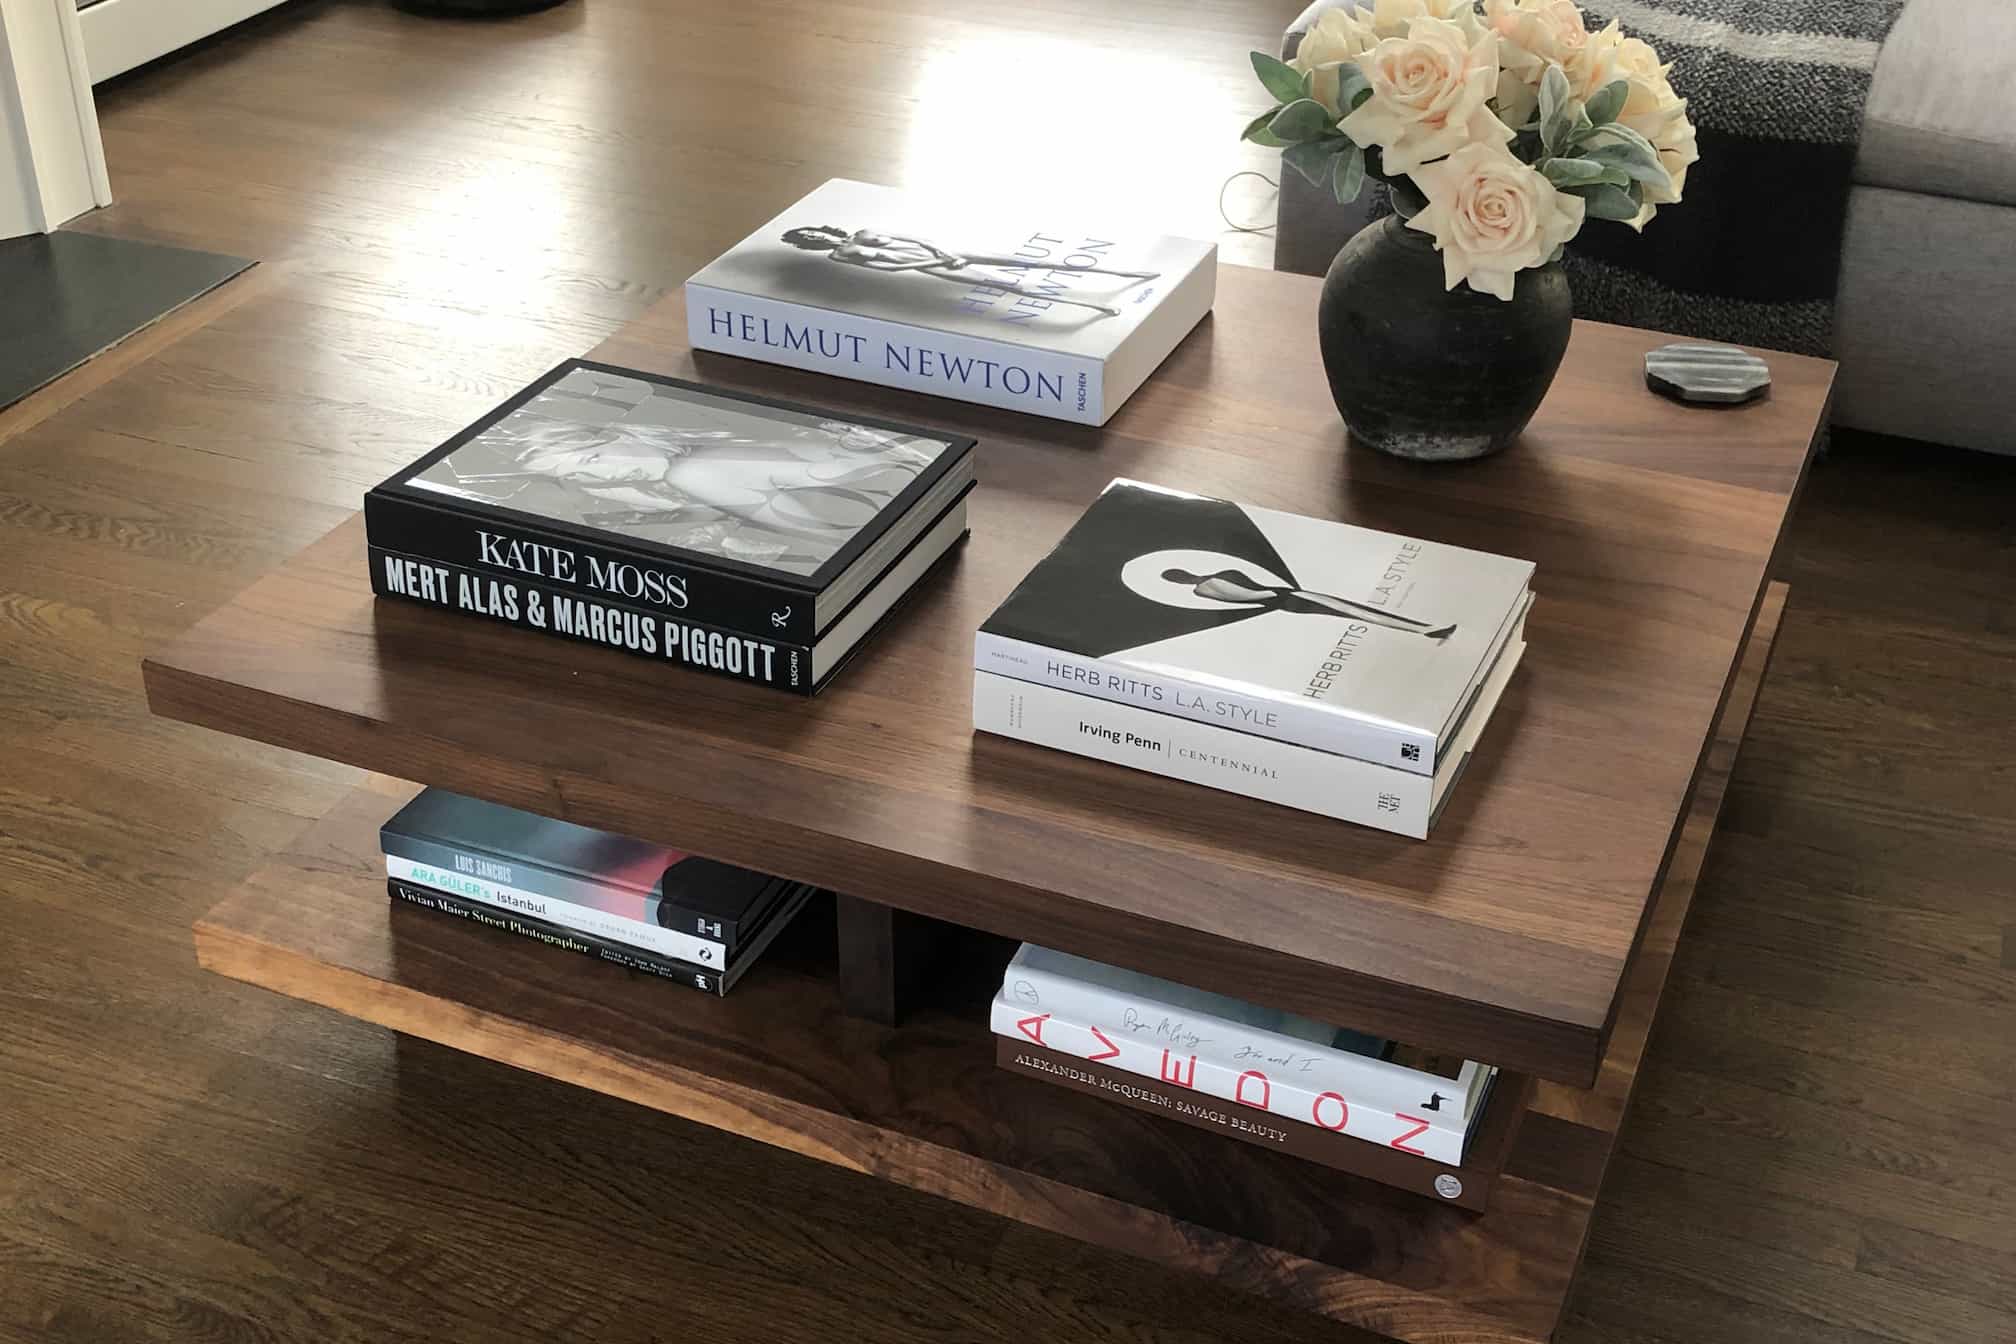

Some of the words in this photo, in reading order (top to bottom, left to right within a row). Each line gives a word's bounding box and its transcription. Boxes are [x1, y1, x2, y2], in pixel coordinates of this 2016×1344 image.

[957, 232, 1064, 315] HELMUT
[998, 237, 1116, 328] NEWTON
[709, 307, 868, 362] HELMUT
[885, 343, 1065, 402] NEWTON
[1077, 372, 1087, 413] TASCHEN
[475, 530, 578, 583] KATE
[585, 555, 689, 609] MOSS
[1383, 543, 1422, 582] STYLE
[384, 555, 450, 604] MERT
[458, 573, 519, 627] ALAS
[526, 590, 547, 628] &
[553, 595, 657, 654] MARCUS
[664, 621, 776, 682] PIGGOTT
[789, 650, 799, 687] TASCHEN
[1047, 660, 1101, 685] HERB
[1108, 675, 1163, 701] RITTS
[1175, 690, 1209, 713] L.A.
[1215, 701, 1279, 728] STYLE
[1303, 658, 1342, 699] HERB
[1336, 623, 1368, 661] RITTS
[1079, 720, 1121, 744] Irving
[1125, 731, 1162, 751] Penn
[1178, 747, 1280, 779] CENTENNIAL
[411, 867, 437, 883] ARA
[496, 890, 547, 915] Istanbul
[455, 854, 475, 873] LUIS
[475, 858, 513, 883] SANCHIS
[399, 887, 435, 907] Vivian
[437, 898, 470, 918] Maier
[471, 910, 507, 929] Street
[509, 920, 590, 953] Photographer
[1015, 1053, 1097, 1086] ALEXANDER
[1176, 1101, 1227, 1125] SAVAGE
[1231, 1116, 1288, 1142] BEAUTY
